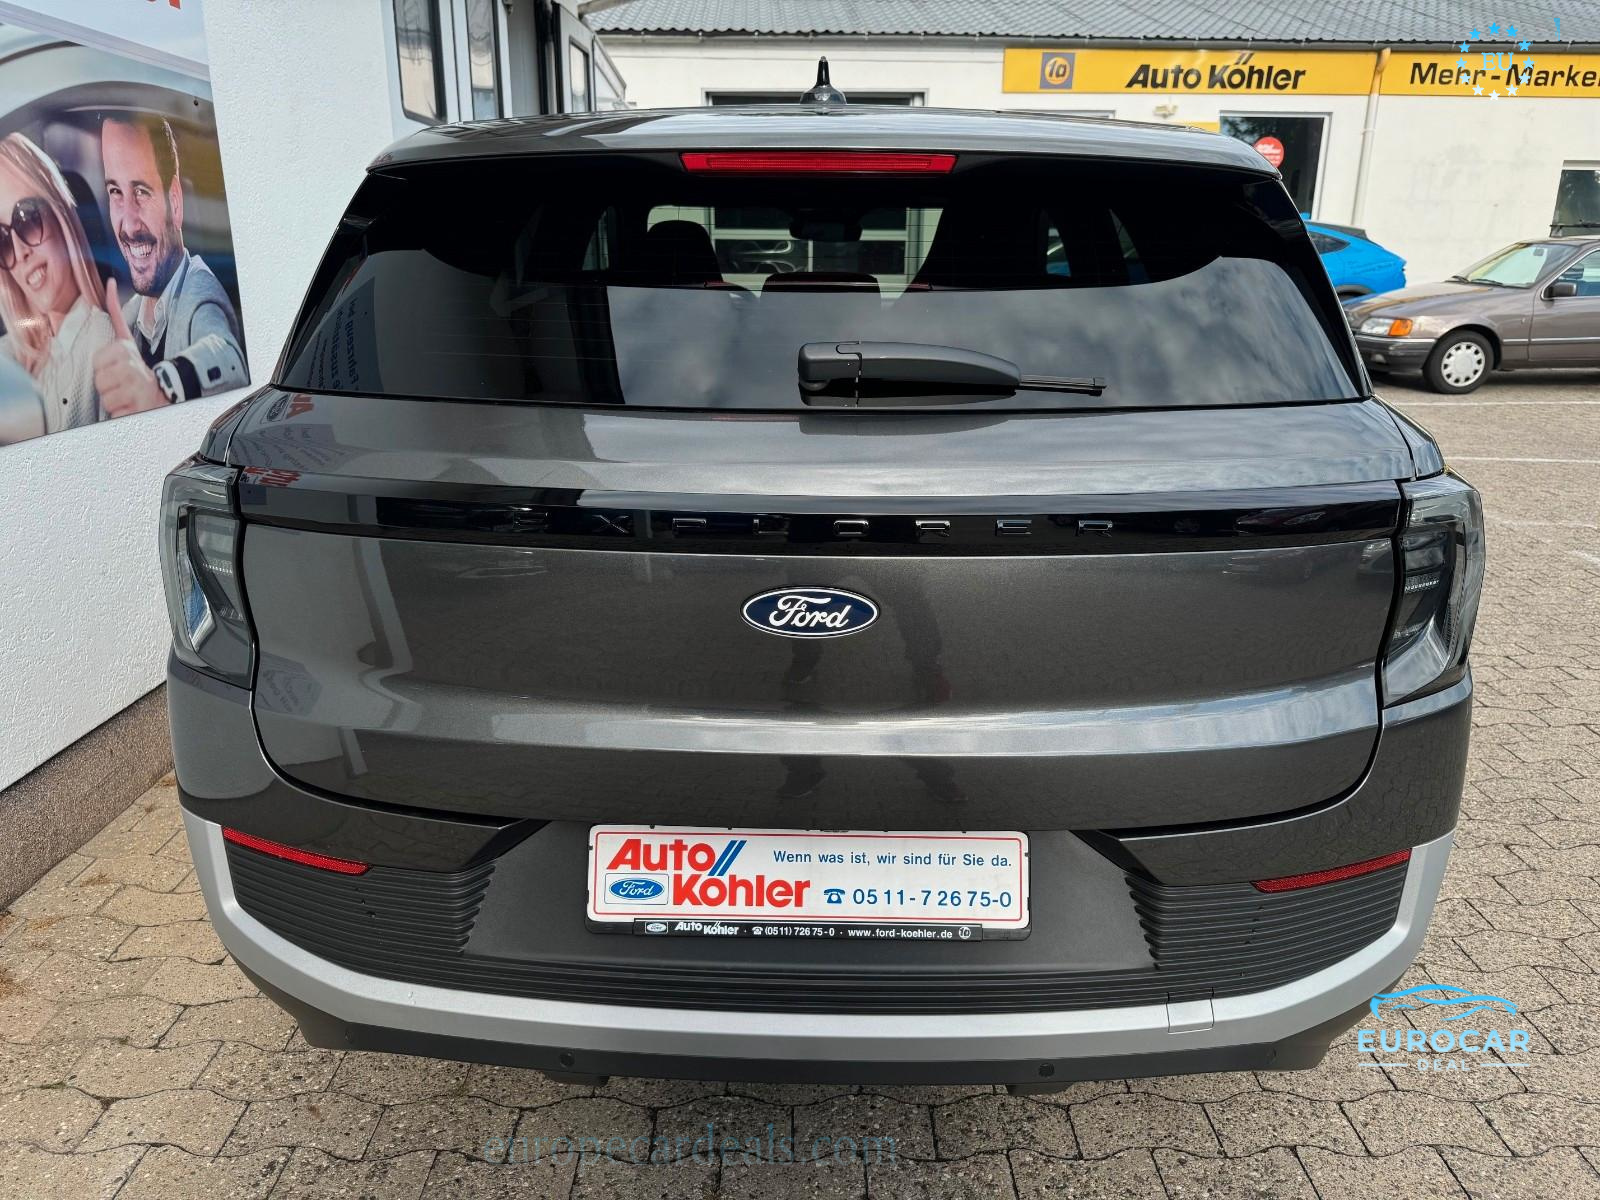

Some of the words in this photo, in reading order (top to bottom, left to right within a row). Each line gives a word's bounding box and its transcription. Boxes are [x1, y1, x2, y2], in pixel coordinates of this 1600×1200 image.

[1125, 64, 1202, 89] Auto
[1207, 53, 1307, 90] Köhler
[512, 508, 1114, 538] EXPLORER
[768, 595, 852, 628] Ford
[606, 838, 716, 872] Auto
[773, 849, 812, 863] Wenn
[818, 853, 844, 864] was
[850, 852, 870, 866] ist,
[876, 853, 897, 865] wir
[903, 852, 932, 866] sind
[938, 852, 957, 866] für
[963, 853, 985, 867] Sie
[991, 854, 1012, 867] da.
[618, 880, 654, 897] Ford
[675, 921, 702, 932] Auto
[848, 927, 953, 939] www.ford-koehler.de
